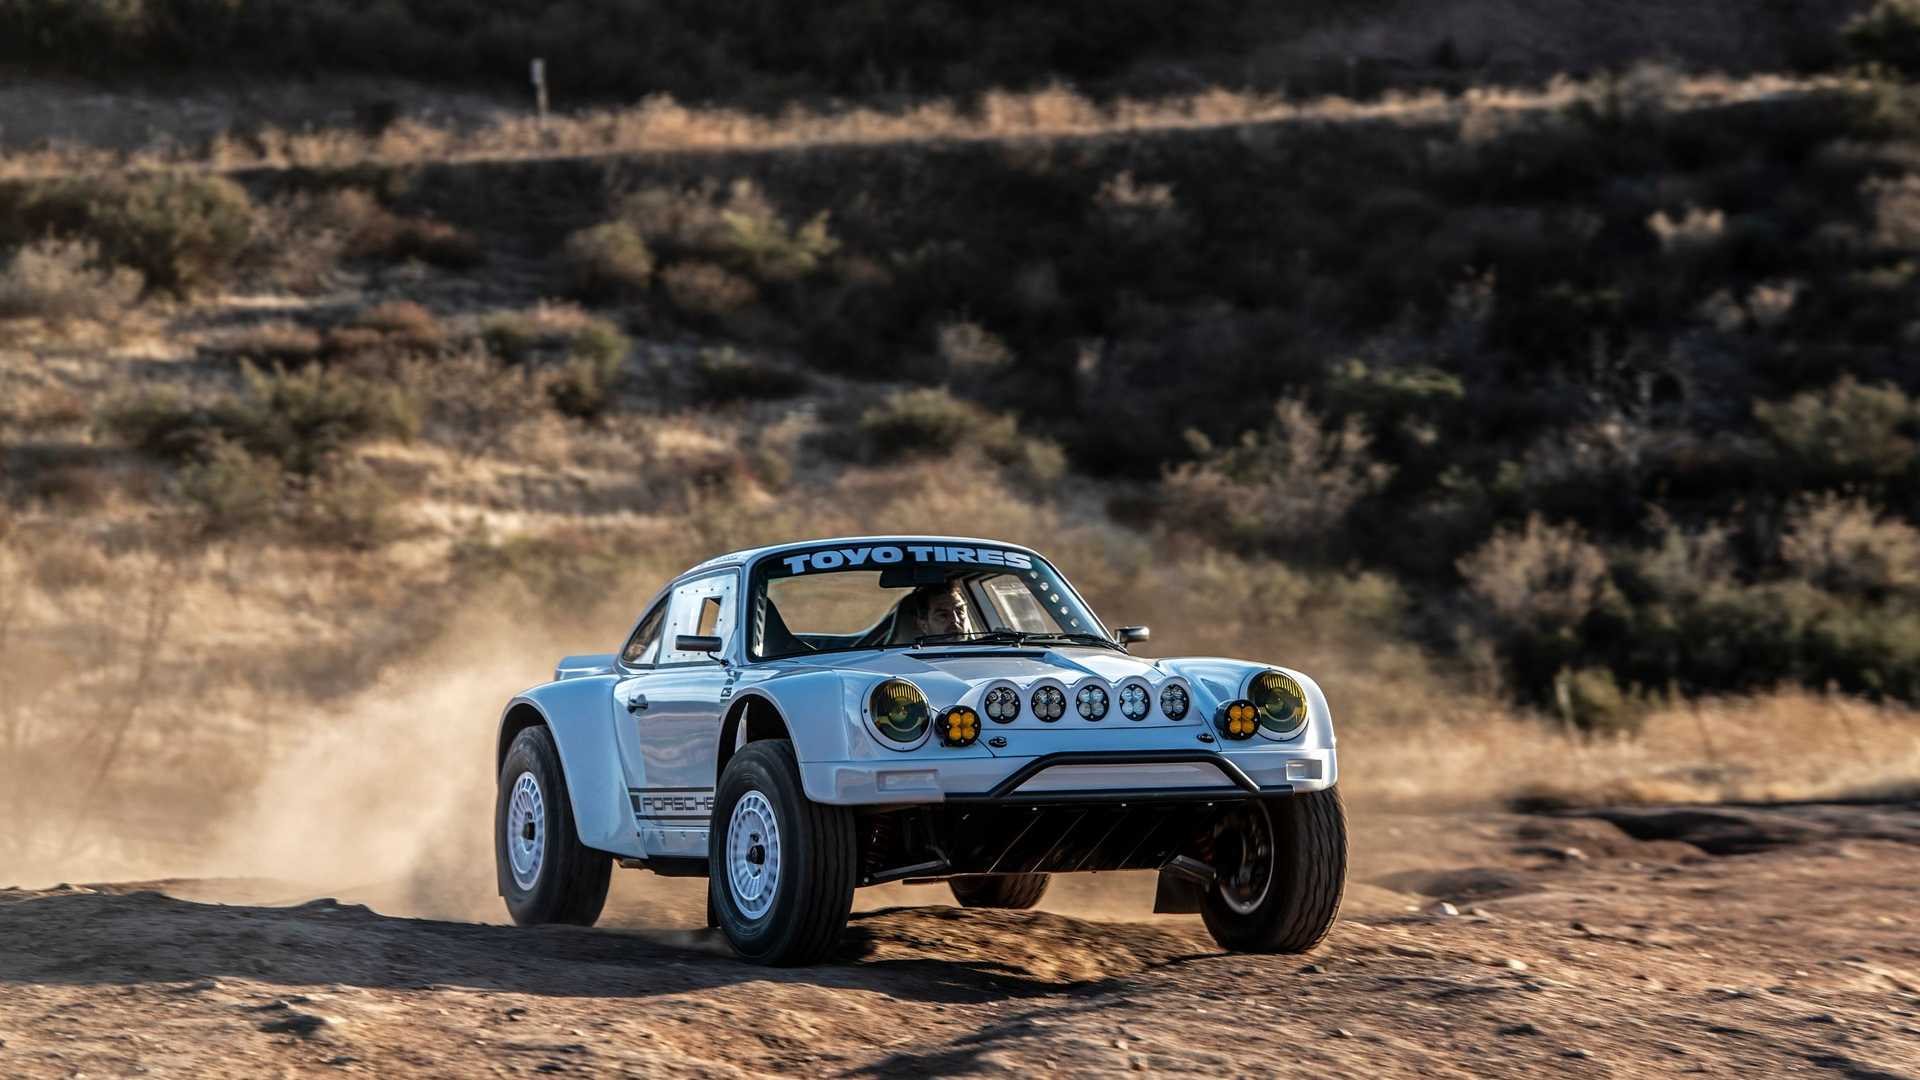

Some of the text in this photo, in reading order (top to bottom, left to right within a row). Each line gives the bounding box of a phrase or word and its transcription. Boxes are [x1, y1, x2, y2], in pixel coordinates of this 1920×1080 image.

[784, 546, 1032, 574] TOYO TIRES
[642, 797, 714, 811] PORSCHE
